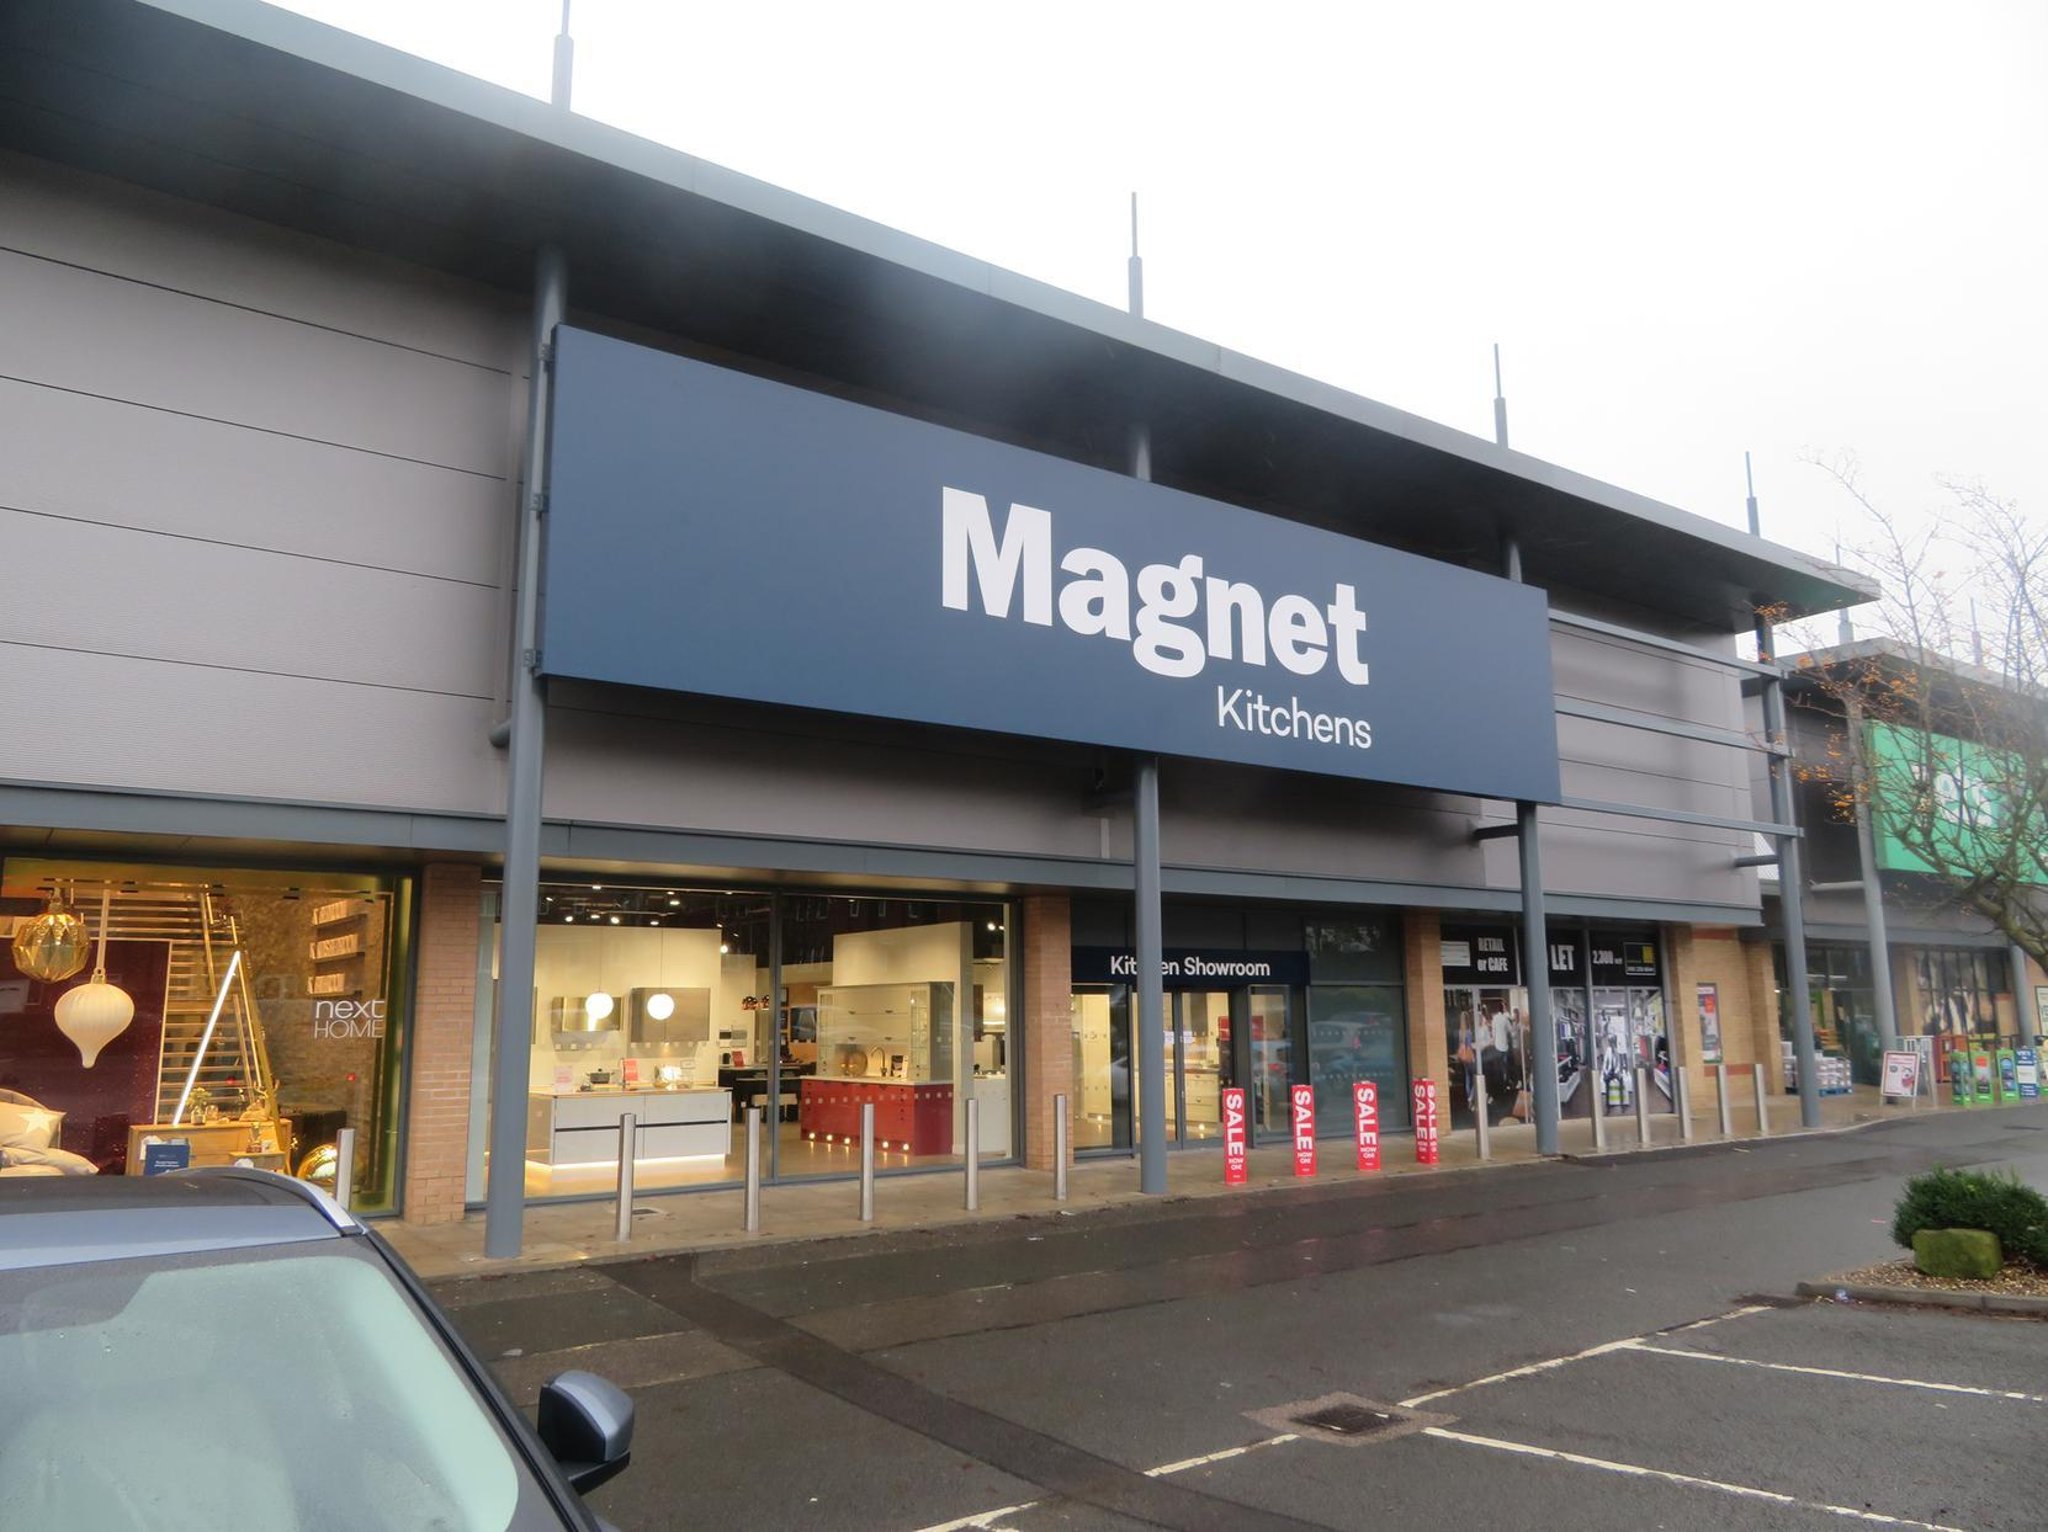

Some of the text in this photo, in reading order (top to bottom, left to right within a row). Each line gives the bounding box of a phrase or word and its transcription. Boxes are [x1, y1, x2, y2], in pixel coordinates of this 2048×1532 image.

[942, 486, 1370, 685] Magnet
[1217, 686, 1372, 749] Kitchens
[1110, 955, 1271, 976] Kiten Showroom
[1488, 957, 1508, 972] CAFE
[1550, 944, 1574, 971] LET
[314, 1020, 384, 1039] HOME
[315, 999, 385, 1019] next
[1226, 1094, 1244, 1155] SALE
[1294, 1091, 1313, 1151] SALE
[1357, 1088, 1377, 1145] SALE
[1414, 1085, 1428, 1140] SALE
[1427, 1085, 1438, 1140] SALE
